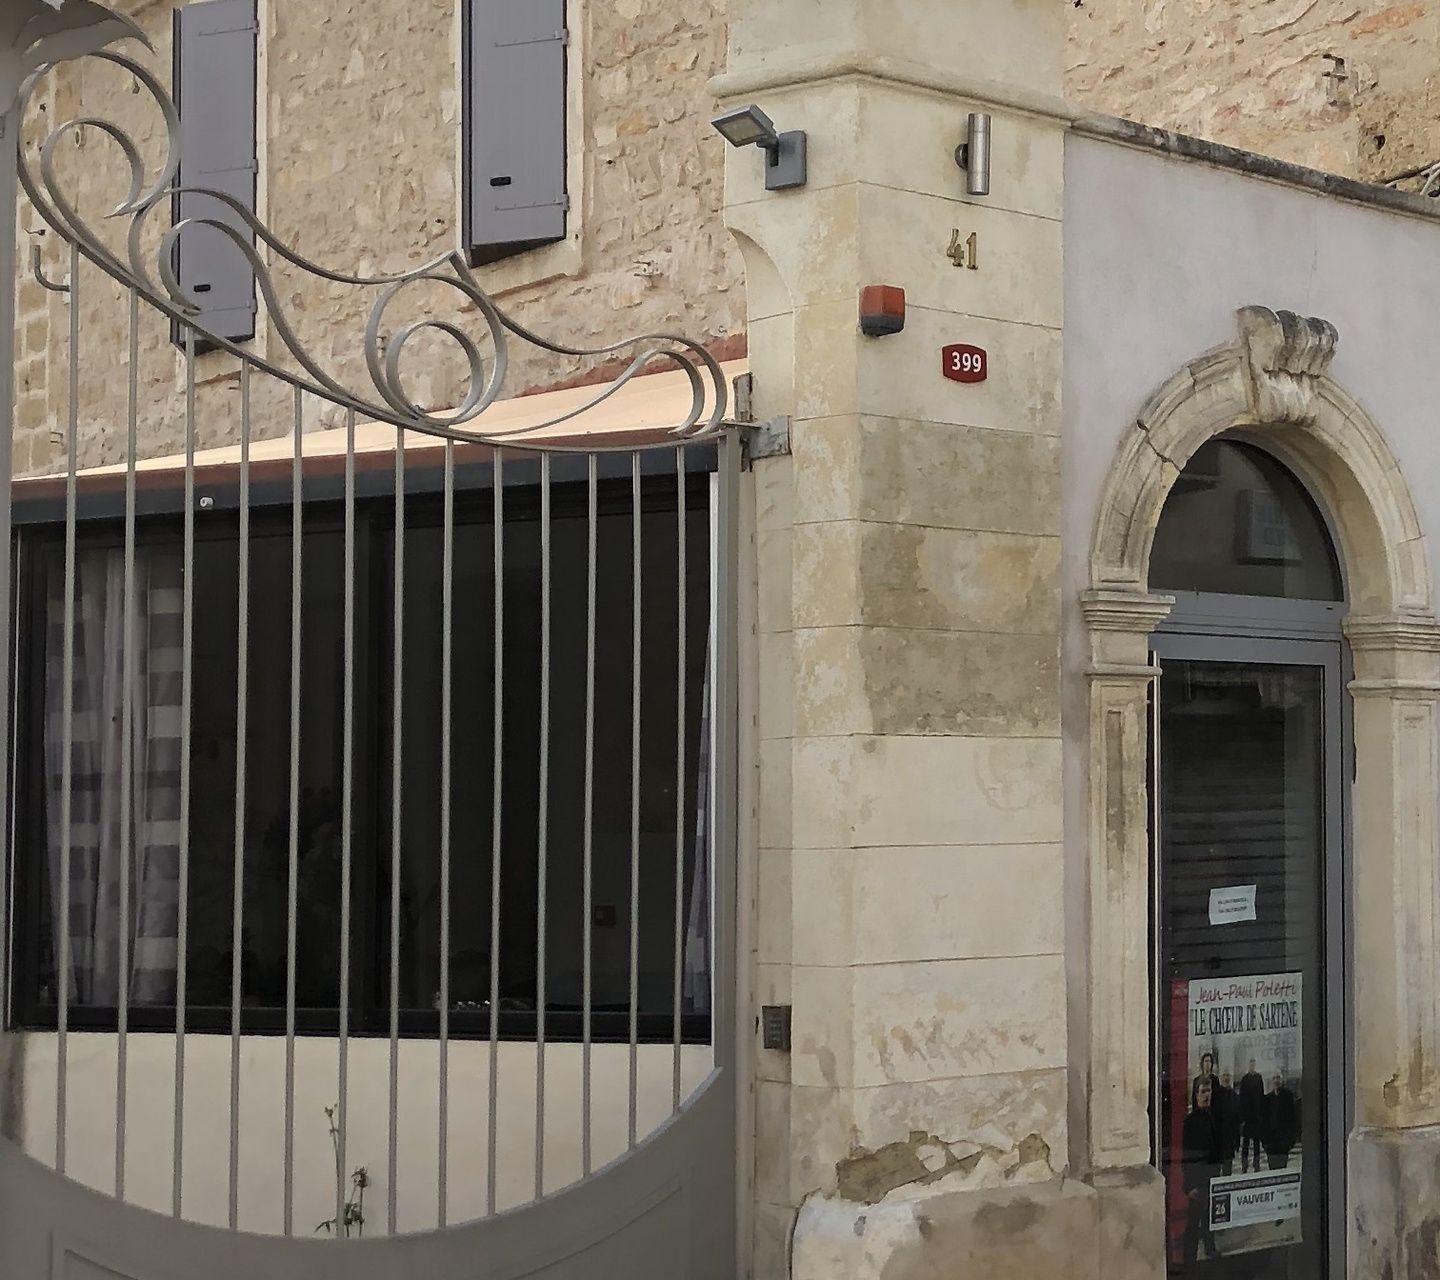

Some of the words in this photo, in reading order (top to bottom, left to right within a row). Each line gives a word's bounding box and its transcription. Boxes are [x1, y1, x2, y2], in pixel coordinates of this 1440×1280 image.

[946, 228, 978, 270] 41
[951, 352, 982, 373] 399
[1196, 984, 1252, 1005] Jean-Paul
[1195, 1008, 1206, 1036] LE
[1246, 1003, 1257, 1031] DE
[1215, 1203, 1226, 1215] 26
[1236, 1191, 1275, 1206] VAUVERT
